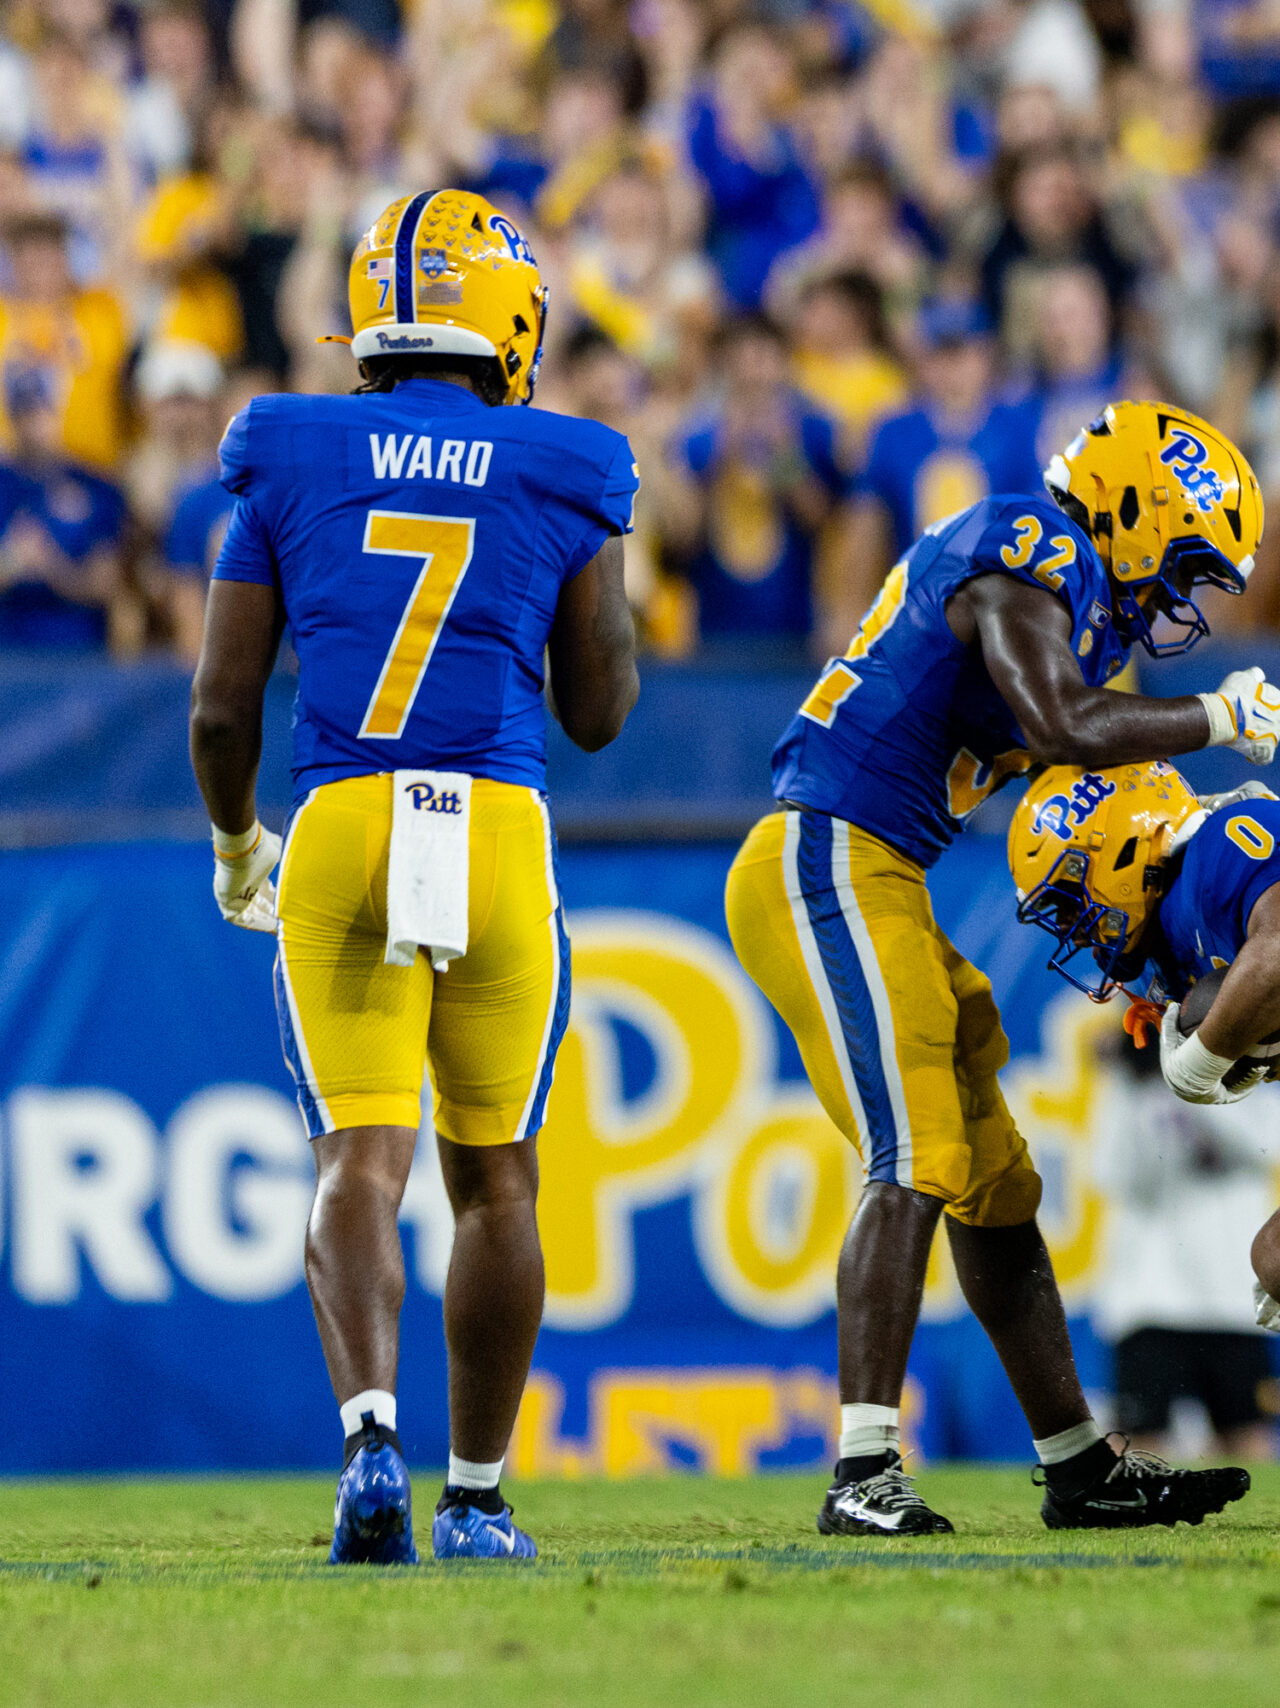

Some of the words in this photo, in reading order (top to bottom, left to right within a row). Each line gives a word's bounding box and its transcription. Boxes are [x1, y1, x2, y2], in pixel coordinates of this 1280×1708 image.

[378, 279, 390, 310] 7
[369, 434, 493, 487] WARD
[1160, 429, 1226, 512] Pitt
[1001, 515, 1076, 591] 32
[357, 510, 476, 739] 7
[405, 782, 461, 814] Pitt
[1032, 772, 1117, 841] Pitt
[1225, 815, 1274, 859] 0
